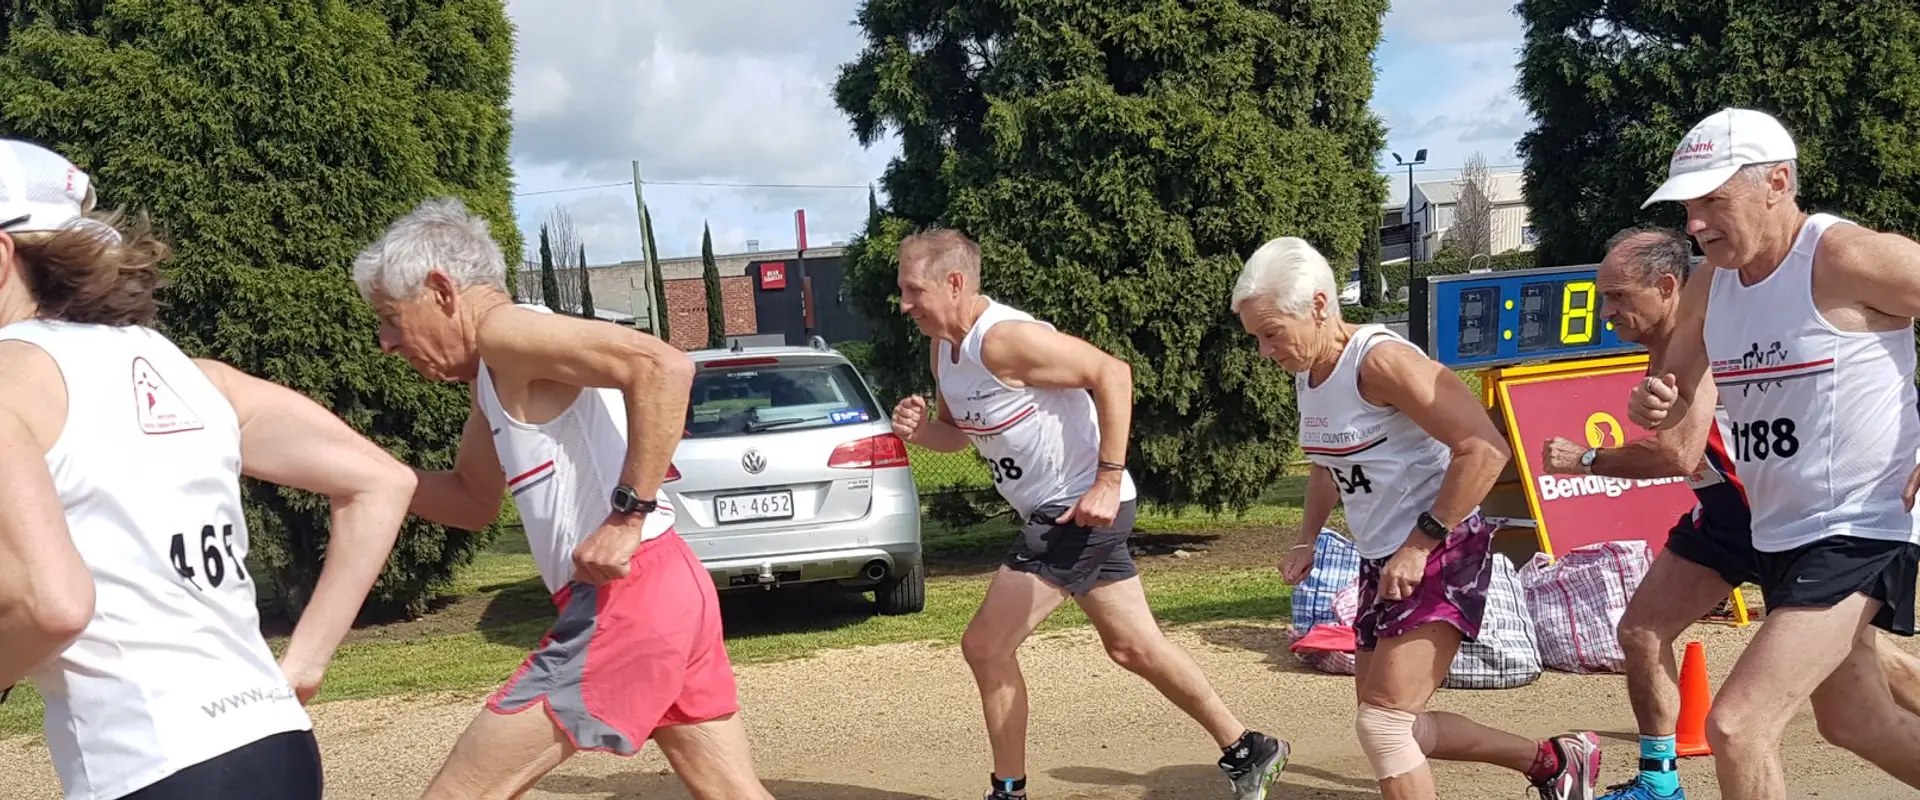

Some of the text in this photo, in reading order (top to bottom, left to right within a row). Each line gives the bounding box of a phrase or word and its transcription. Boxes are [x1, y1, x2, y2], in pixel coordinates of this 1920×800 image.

[1321, 431, 1356, 444] COUNTRY
[1356, 423, 1382, 440] CLUB
[1731, 417, 1799, 462] 1188
[1327, 464, 1373, 494] 54
[1538, 475, 1632, 500] Bendigo
[170, 524, 245, 590] 465
